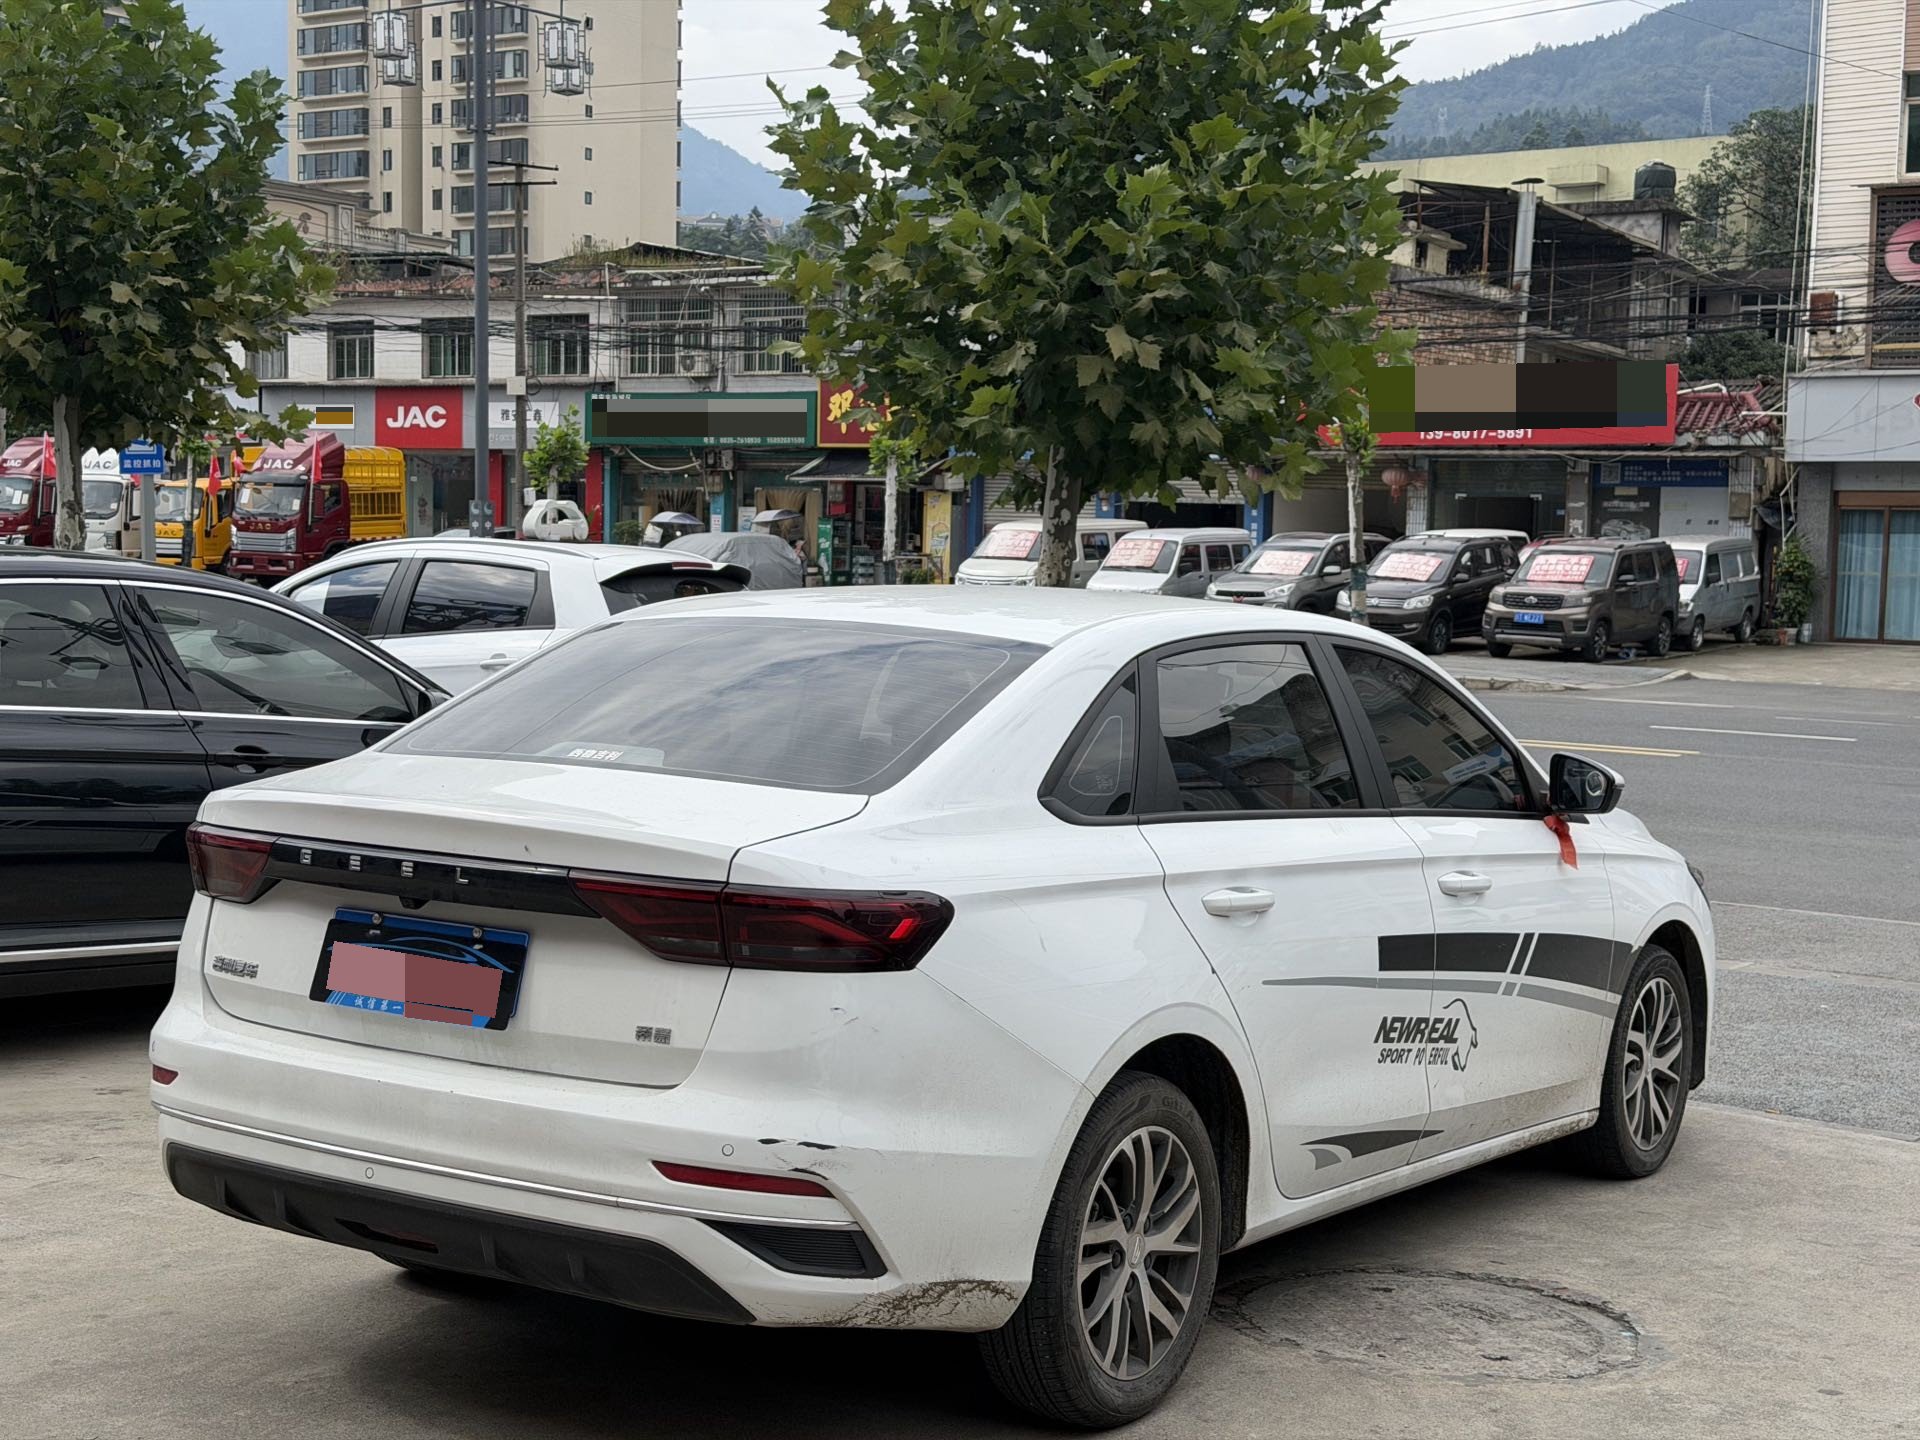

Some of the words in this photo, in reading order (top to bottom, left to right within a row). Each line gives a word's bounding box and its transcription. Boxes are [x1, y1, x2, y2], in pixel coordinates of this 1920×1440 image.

[386, 405, 448, 429] JAC
[3, 458, 22, 467] JAC
[84, 460, 113, 469] JAC
[263, 459, 294, 469] JAC
[1373, 1016, 1461, 1044] NEWREAL
[1377, 1047, 1412, 1064] SPORT
[1413, 1047, 1450, 1066] POERFUL
